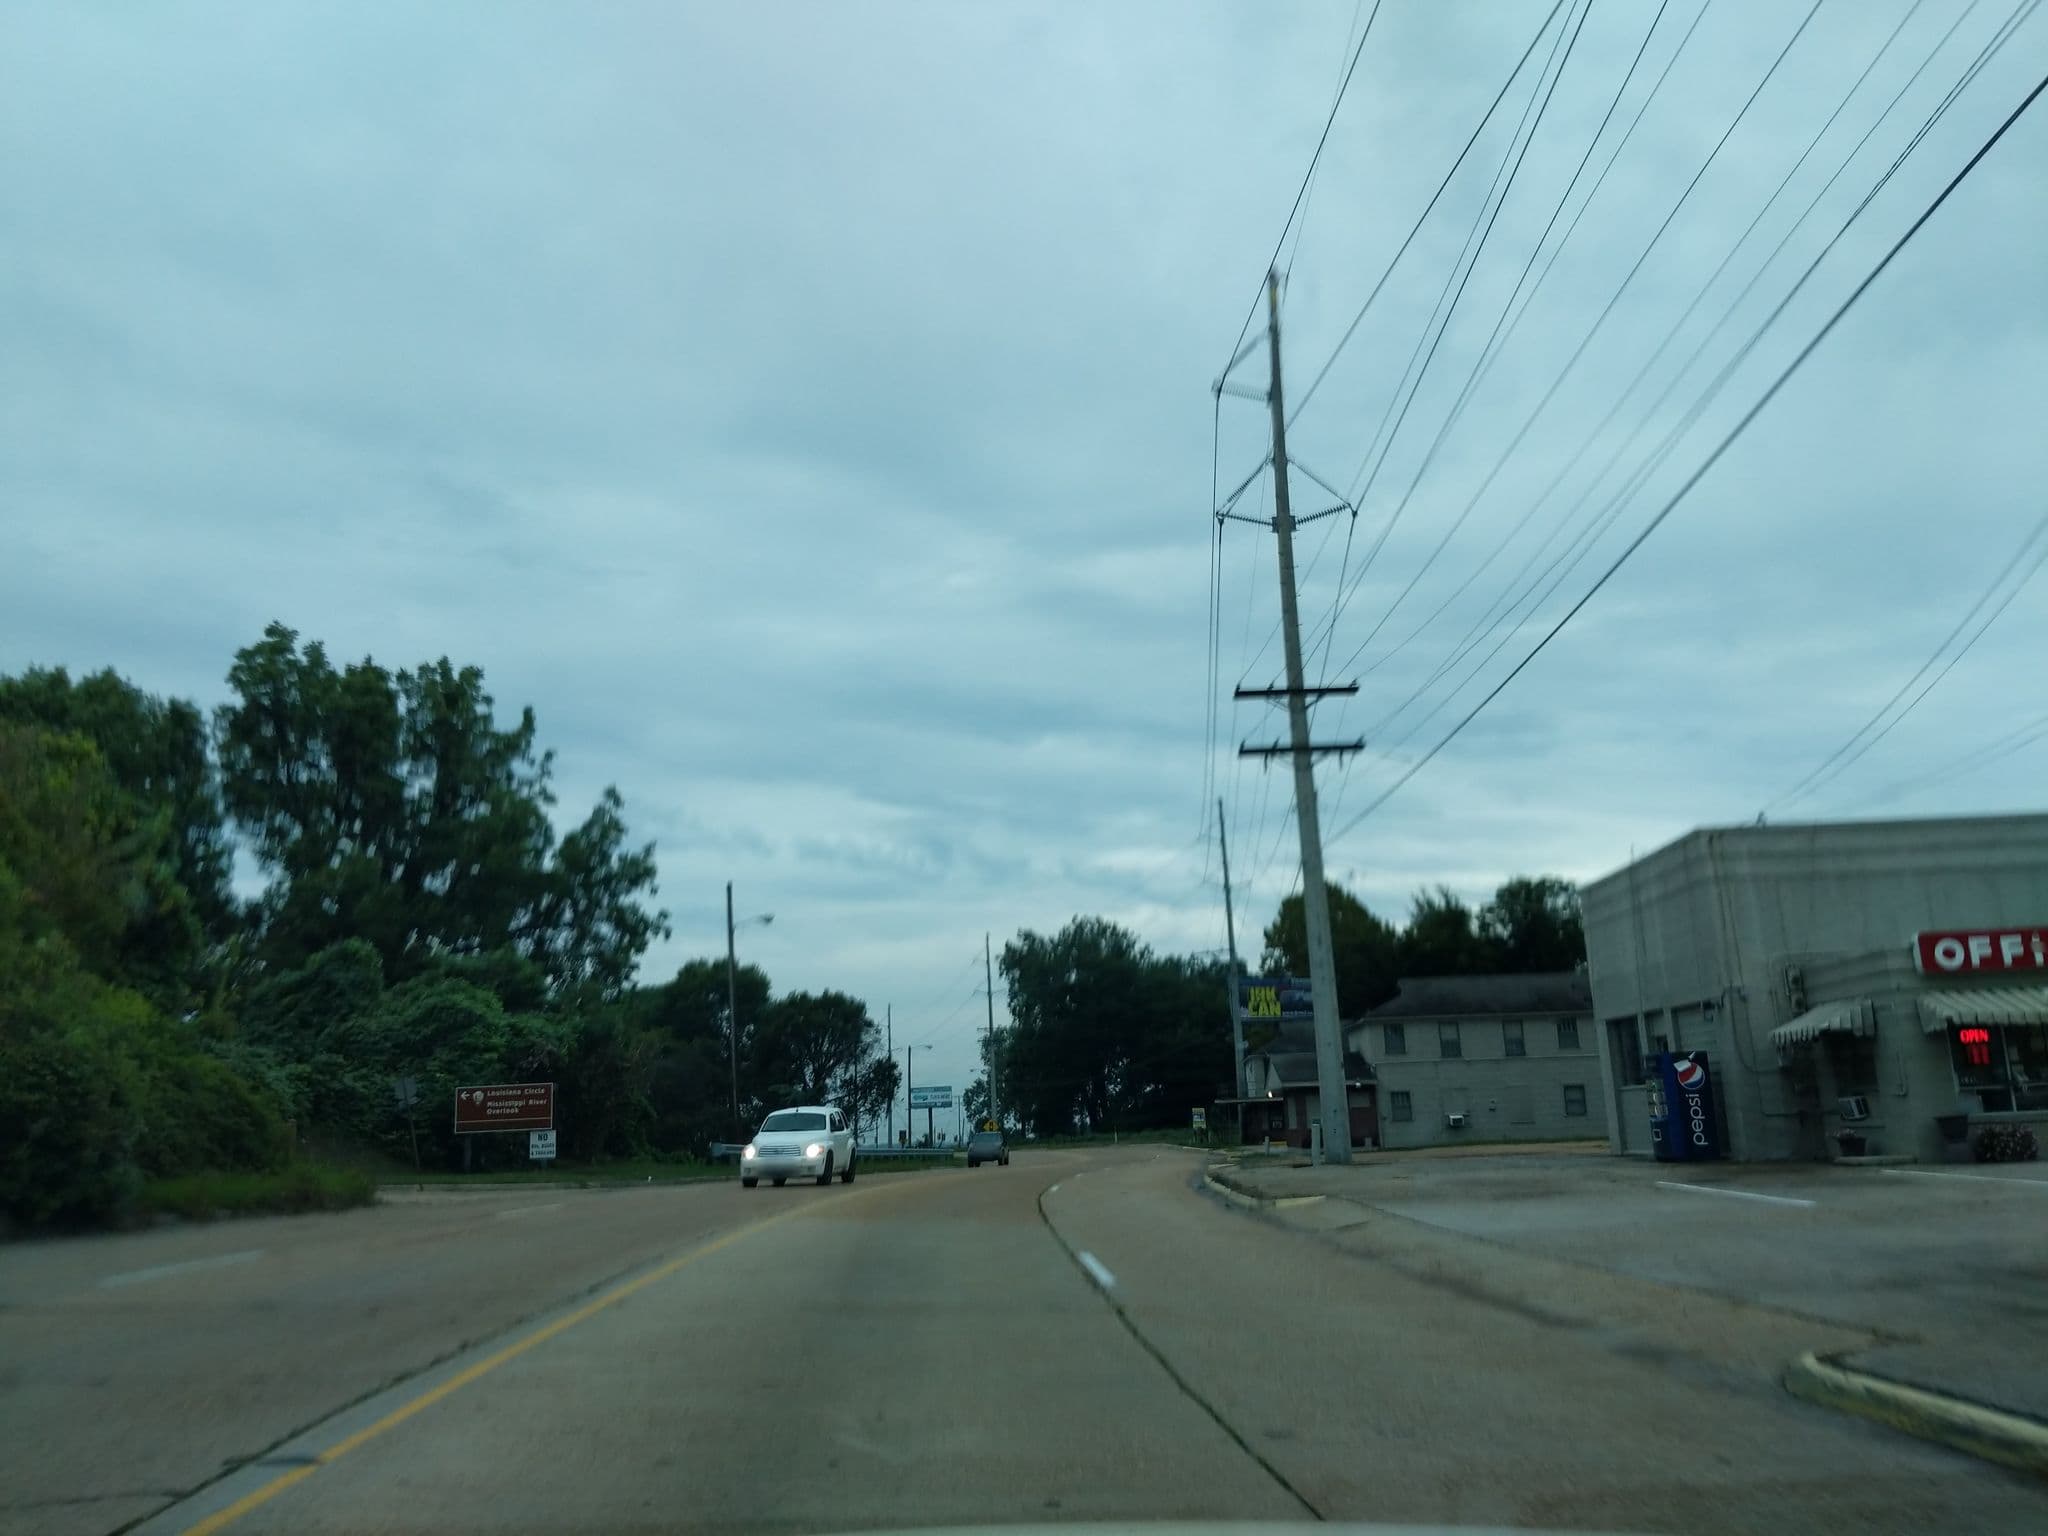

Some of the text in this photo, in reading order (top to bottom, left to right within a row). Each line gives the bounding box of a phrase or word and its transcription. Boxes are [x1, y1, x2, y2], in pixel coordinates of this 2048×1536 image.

[1960, 1027, 1989, 1043] OPEN
[1686, 1094, 1708, 1144] pepsi
[538, 1133, 548, 1142] NO
